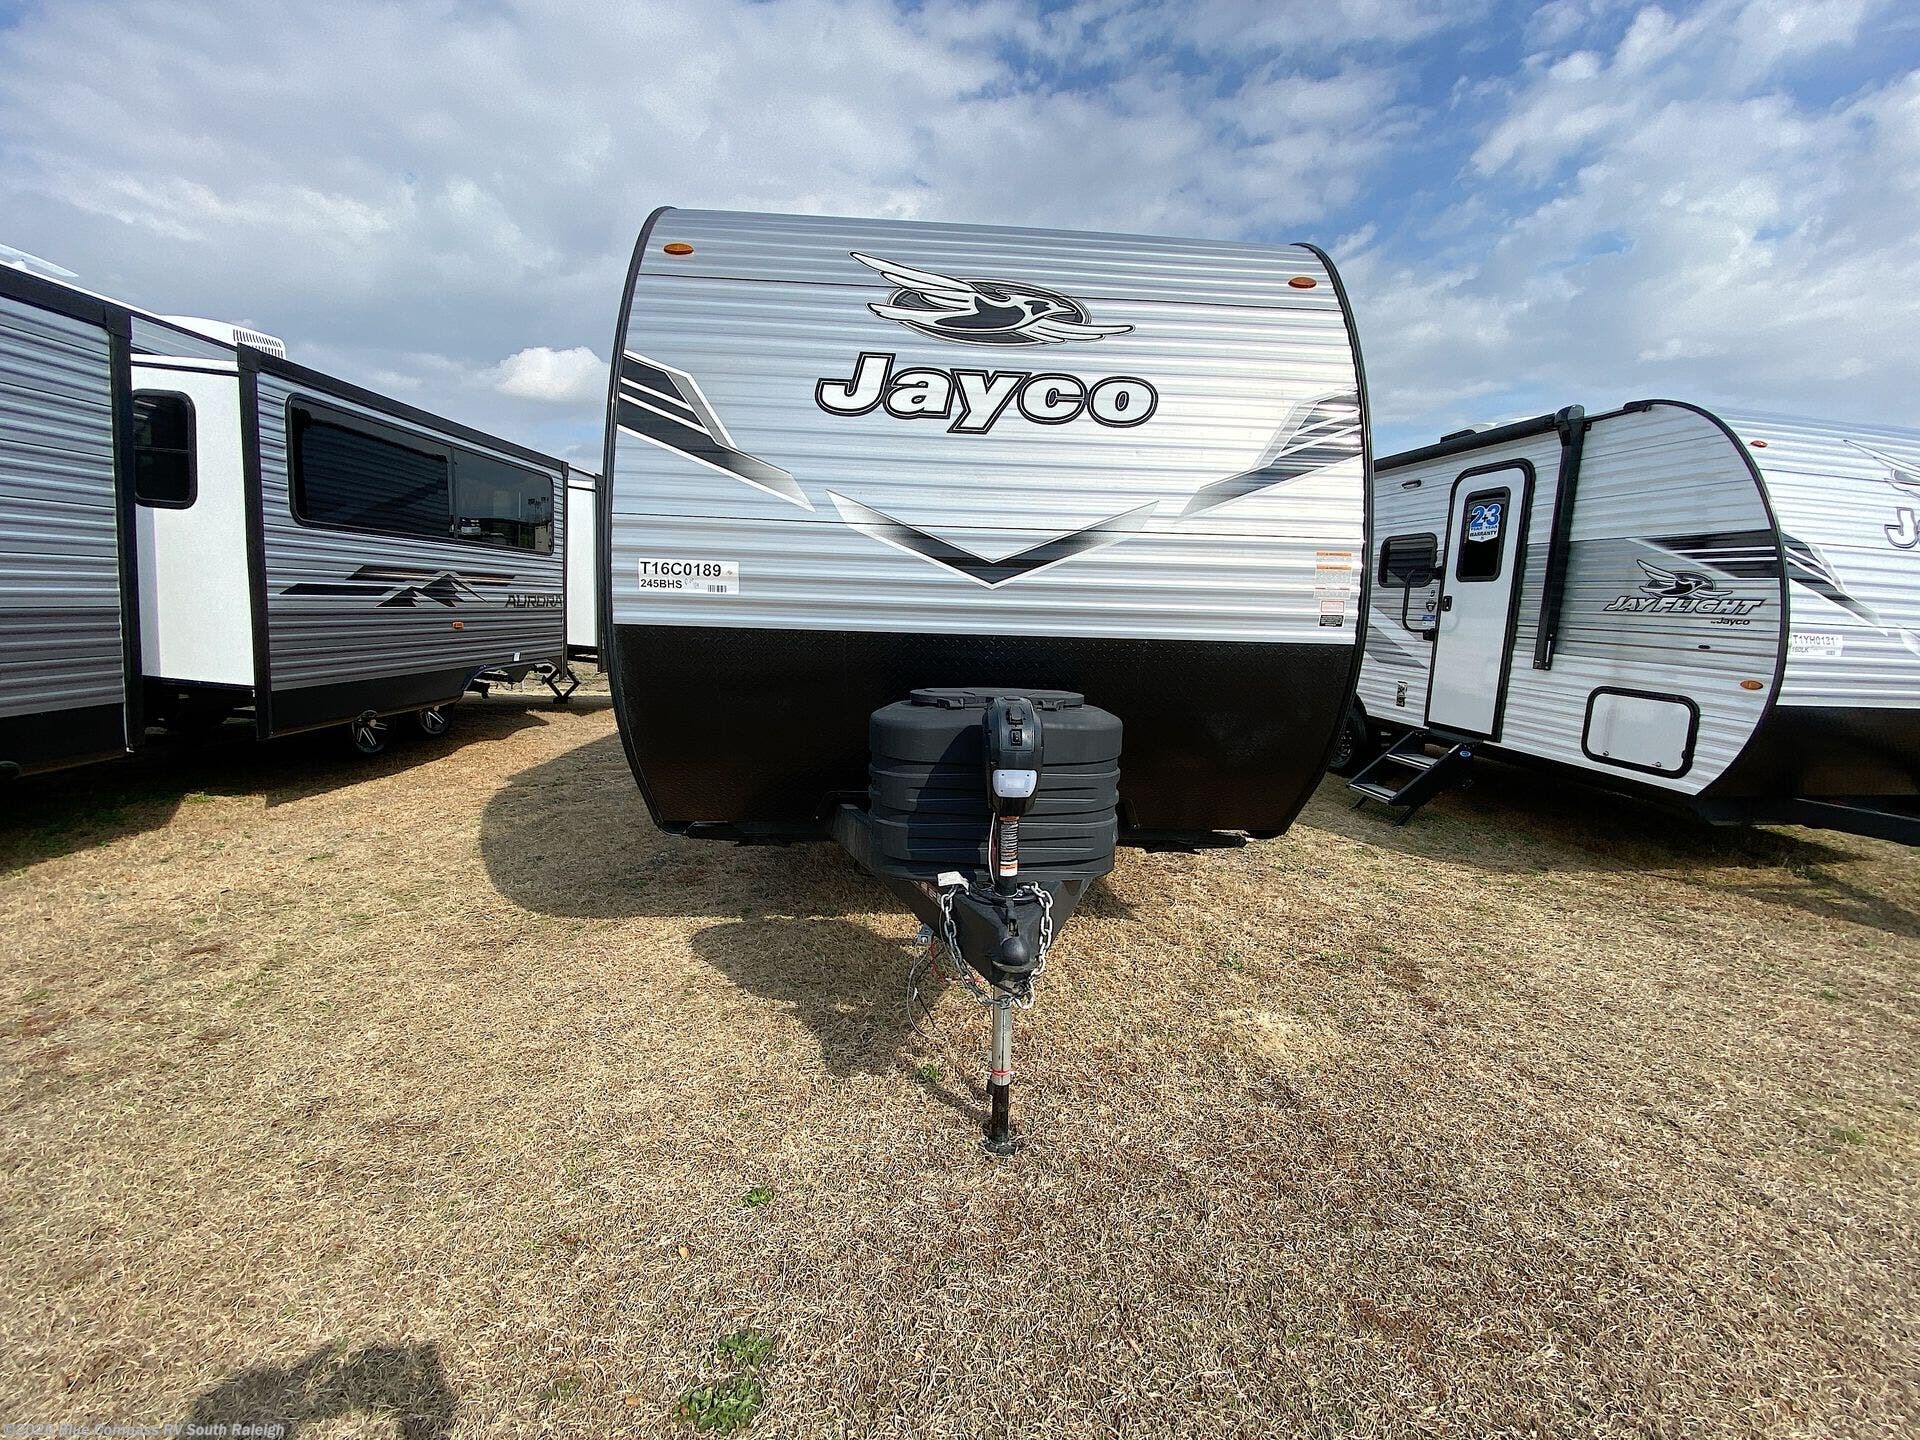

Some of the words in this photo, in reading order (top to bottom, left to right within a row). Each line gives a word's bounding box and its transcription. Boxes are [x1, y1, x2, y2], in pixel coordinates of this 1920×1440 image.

[815, 351, 1159, 434] Jayco
[640, 561, 722, 577] T16C0189
[640, 579, 683, 589] 245BHS
[504, 593, 563, 608] AURORA
[1603, 595, 1657, 612] JAY
[1651, 596, 1767, 616] FLIGHT
[1716, 617, 1750, 627] Jayco
[1793, 634, 1835, 646] T1YH0131
